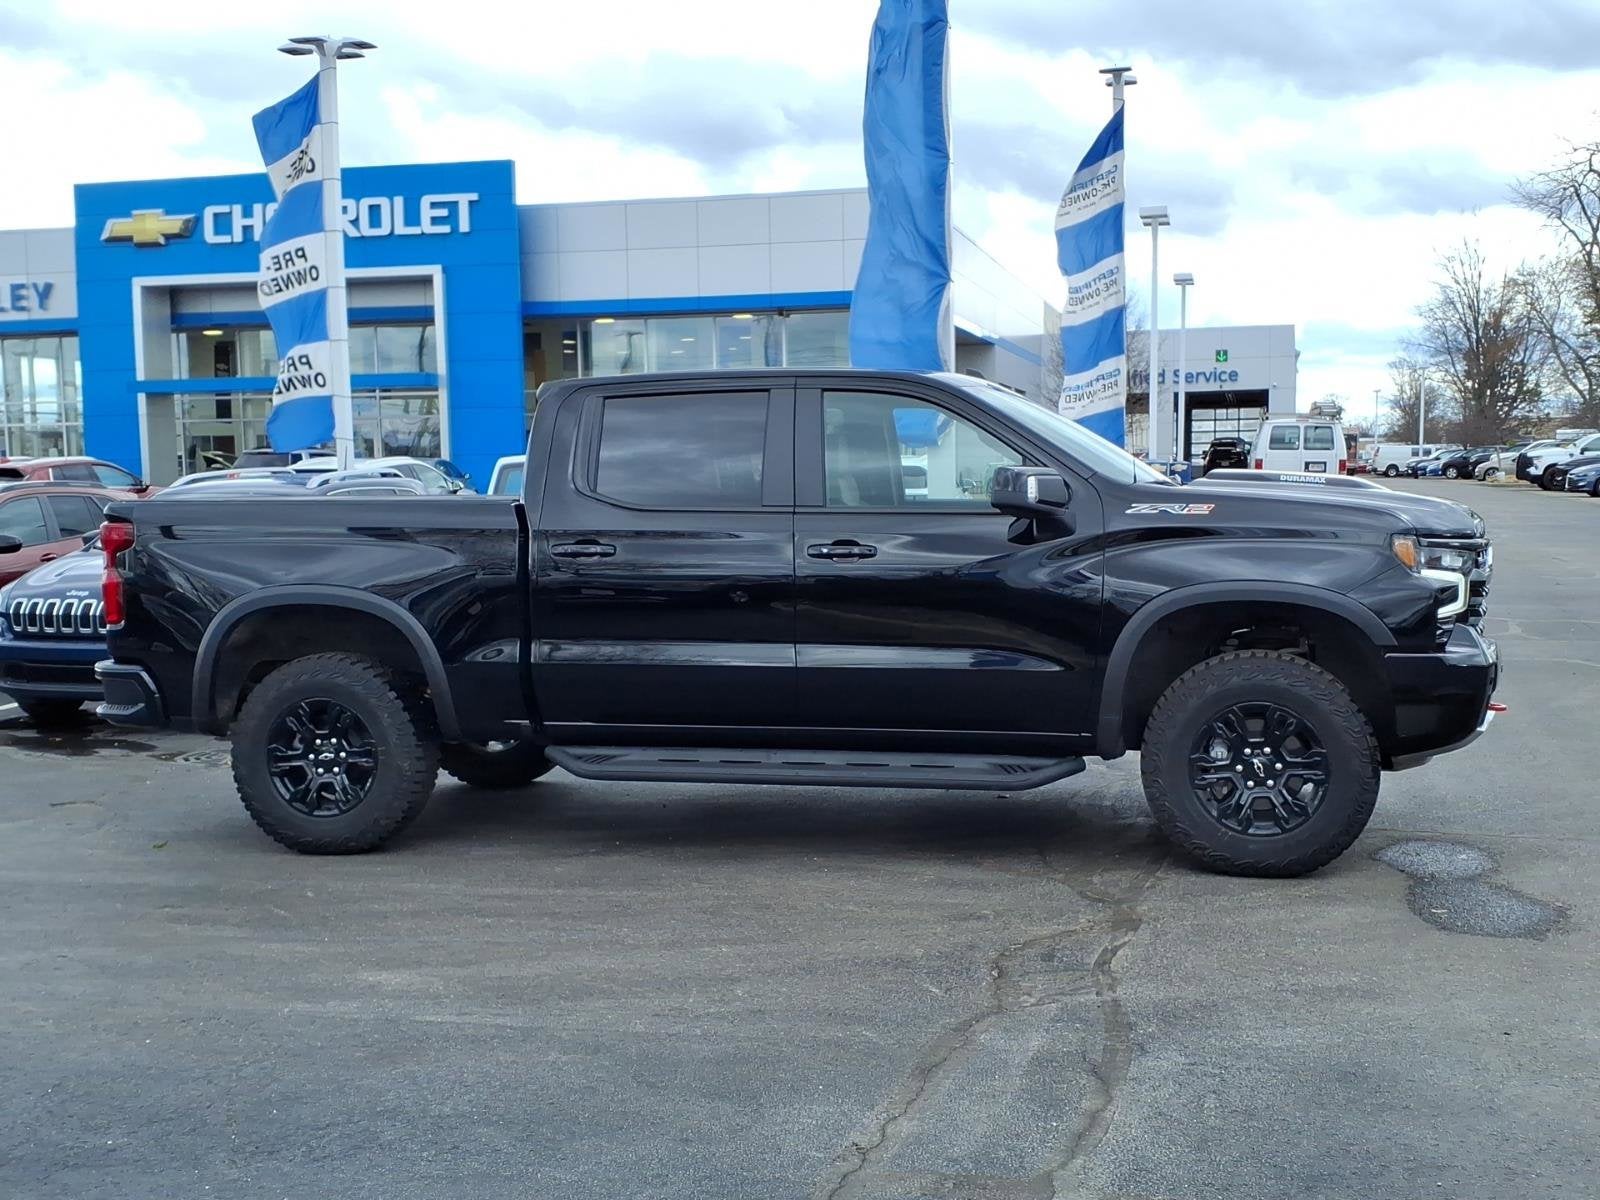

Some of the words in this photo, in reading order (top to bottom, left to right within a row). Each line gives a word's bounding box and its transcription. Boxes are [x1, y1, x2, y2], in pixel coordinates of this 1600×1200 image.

[203, 193, 479, 244] CHROLET
[1173, 367, 1239, 384] Service
[1280, 474, 1327, 484] DURAMAX
[1125, 503, 1215, 515] ZR2
